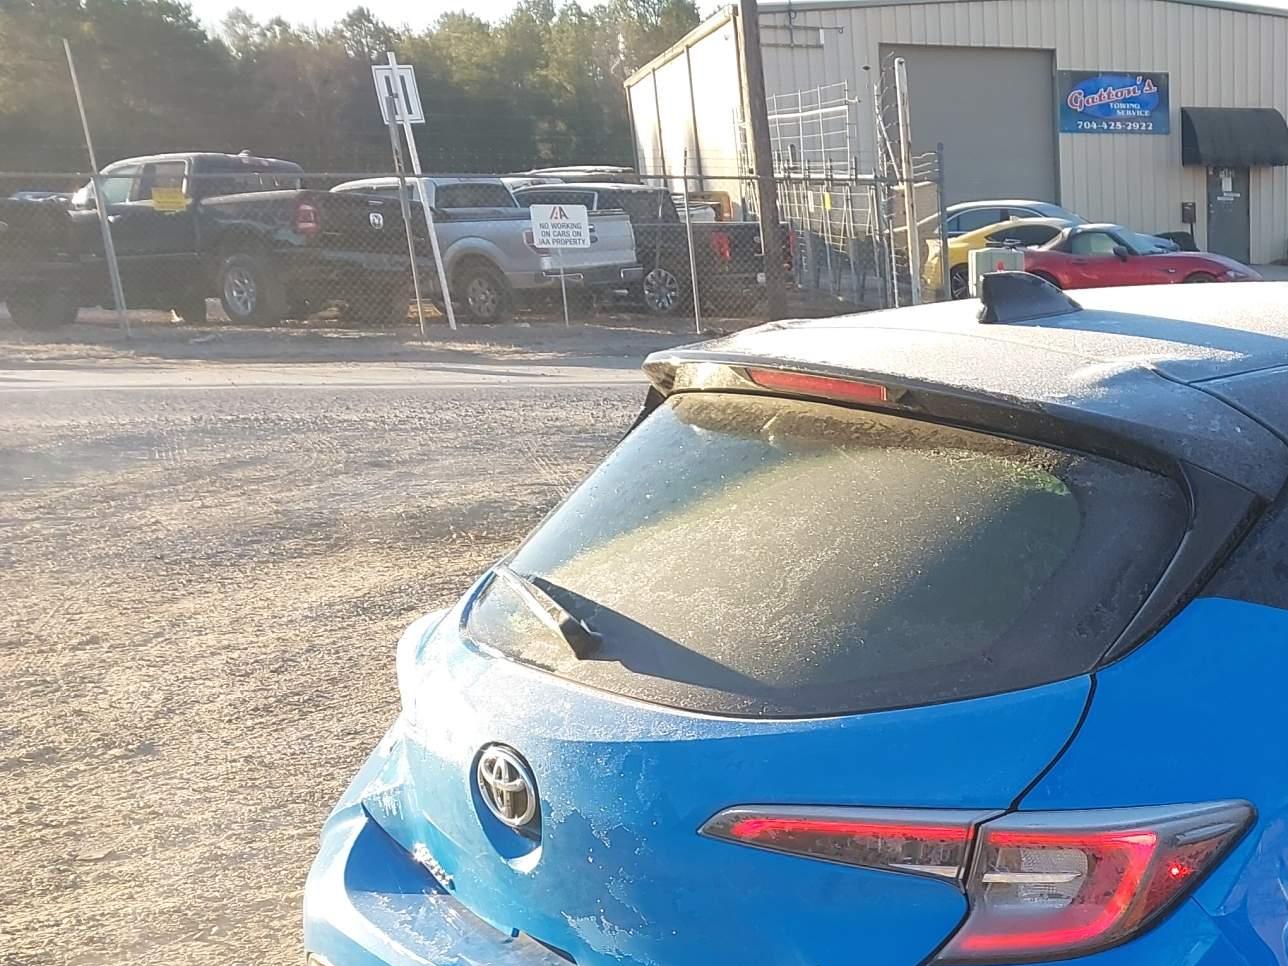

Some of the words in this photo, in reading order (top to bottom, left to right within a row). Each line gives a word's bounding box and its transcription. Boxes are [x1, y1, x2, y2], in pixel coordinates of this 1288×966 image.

[1067, 75, 1158, 112] Gatton's
[1109, 102, 1141, 110] TOWING
[1116, 109, 1151, 117] SERVICE
[539, 222, 550, 230] NO
[551, 222, 583, 230] WORKING
[541, 230, 551, 238] ON
[552, 230, 571, 238] CARS
[572, 230, 582, 238] ON
[538, 238, 551, 246] IAA
[552, 238, 586, 246] PROPERTY
